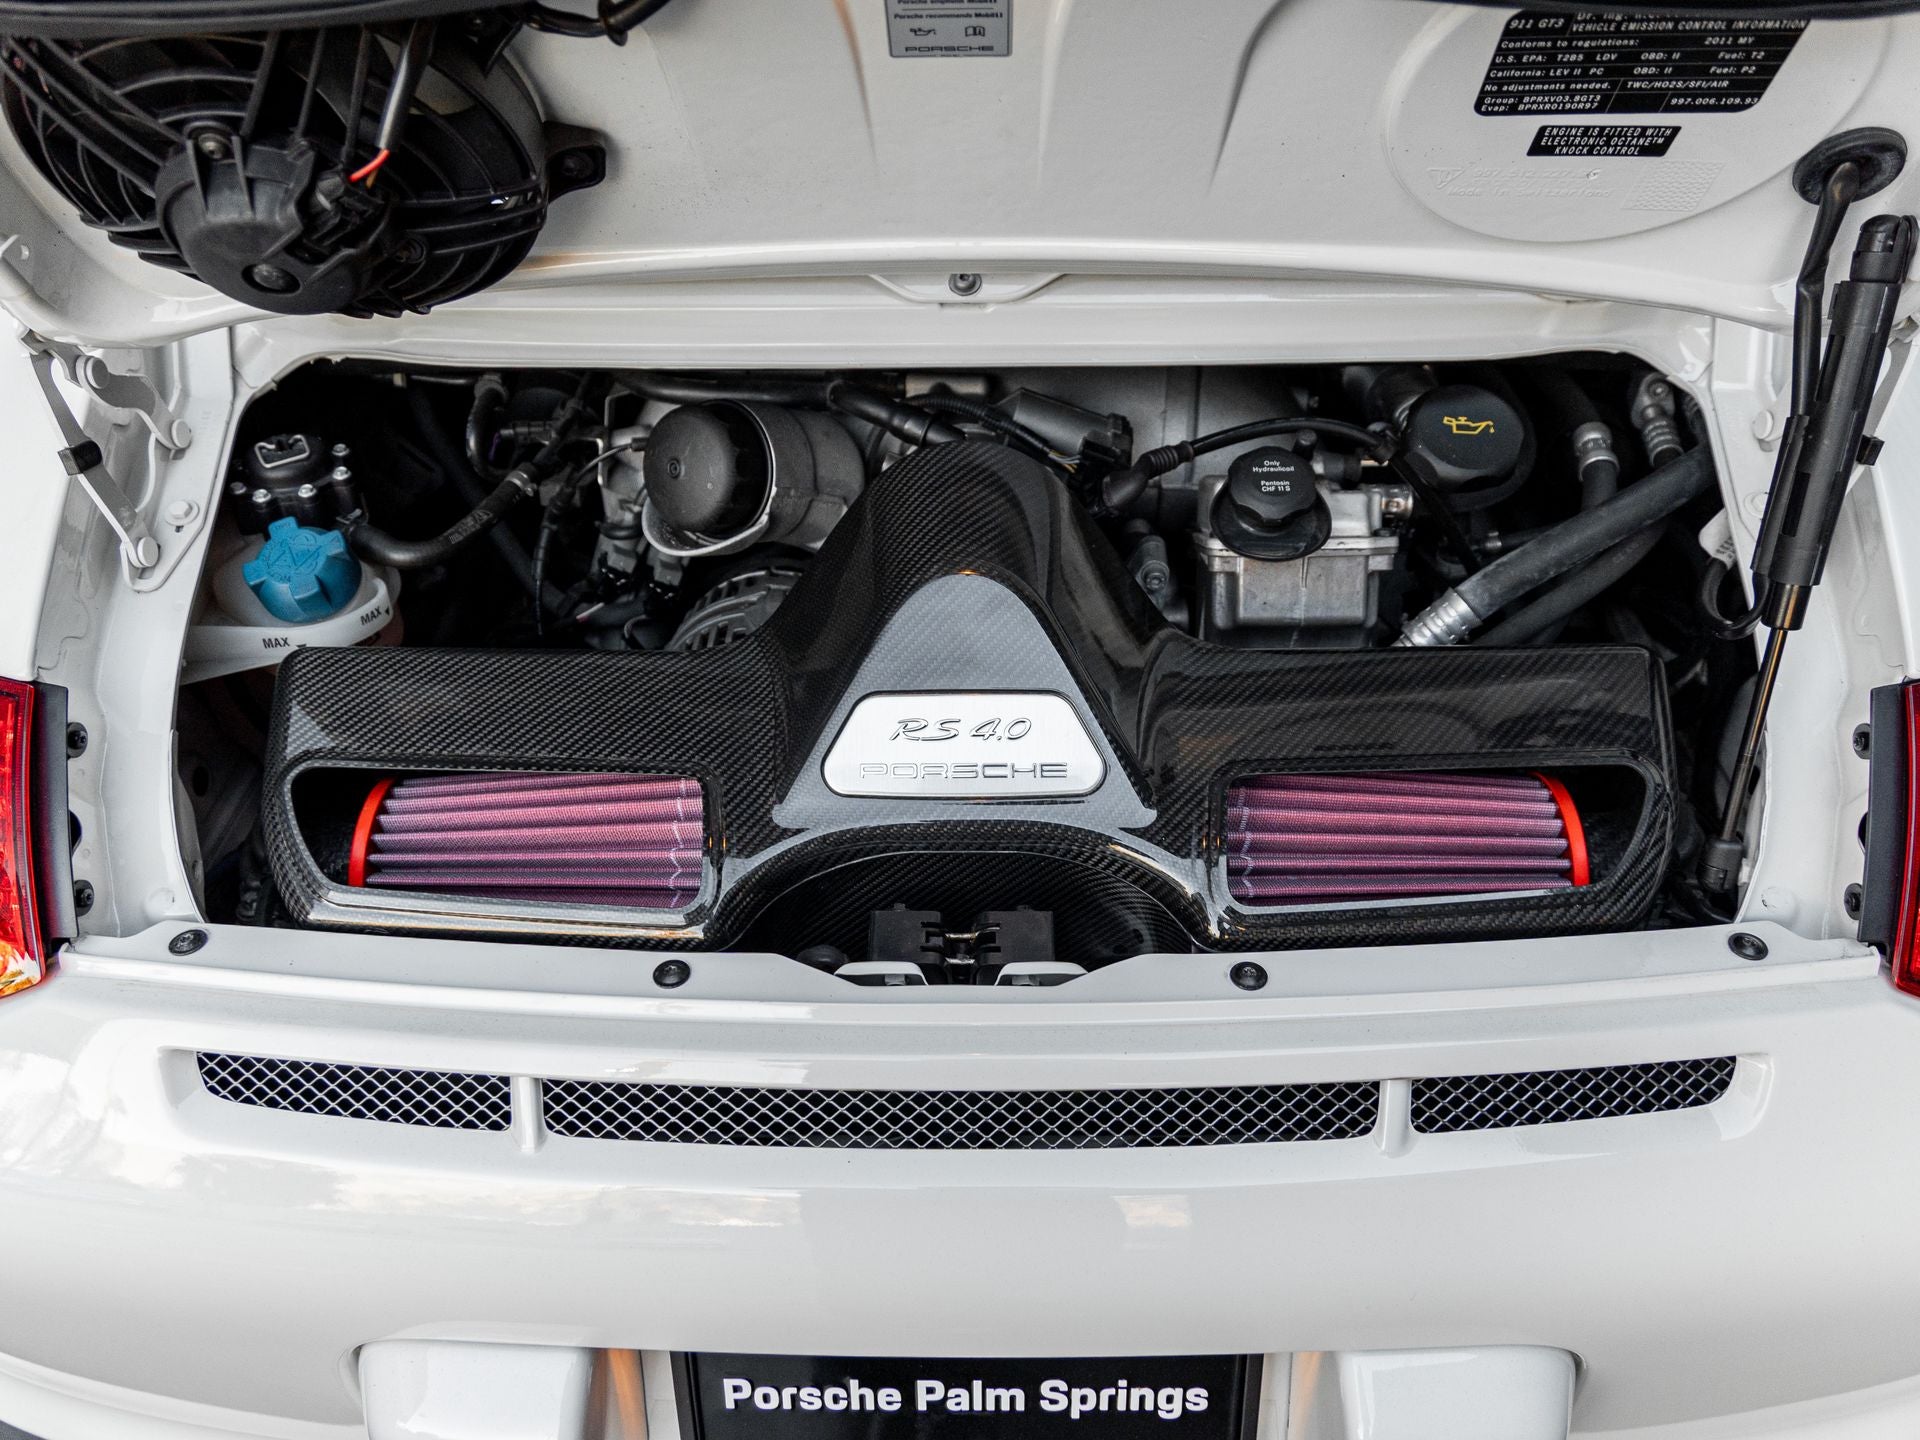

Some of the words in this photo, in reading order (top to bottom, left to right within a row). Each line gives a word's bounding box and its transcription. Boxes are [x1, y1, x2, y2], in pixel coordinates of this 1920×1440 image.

[1508, 19, 1534, 29] 911
[1538, 18, 1565, 29] GT3
[1572, 22, 1617, 32] VEHICLE
[1621, 21, 1674, 31] EMISSION
[1678, 20, 1728, 31] CONTROL
[1732, 19, 1807, 30] INFORMATION
[1501, 40, 1552, 49] Conforms
[1572, 38, 1640, 48] regulations:
[1704, 37, 1733, 45] 2011
[1737, 37, 1755, 45] MY
[1495, 55, 1517, 63] U.S.
[1522, 54, 1547, 63] EPA:
[1595, 53, 1618, 61] LDV
[1641, 52, 1668, 60] OBD:
[1718, 51, 1746, 60] Fuel:
[1751, 51, 1765, 60] T2
[1489, 69, 1546, 78] California:
[1549, 68, 1570, 76] LEV
[1589, 67, 1604, 75] PC
[1633, 67, 1660, 75] OBD:
[1709, 66, 1737, 74] Fuel:
[1740, 66, 1756, 74] P2
[1484, 84, 1498, 92] No
[1502, 83, 1565, 93] adjustments
[1569, 82, 1611, 90] needed.
[1484, 97, 1518, 105] Group:
[1481, 104, 1509, 112] Evap:
[1544, 127, 1584, 136] ENGINE
[1588, 127, 1600, 136] IS
[1603, 127, 1641, 136] FITTED
[1645, 128, 1673, 136] WITH
[1540, 137, 1607, 146] ELECTRONIC
[1554, 146, 1590, 154] KNOCK
[1593, 146, 1640, 155] CONTROL
[360, 606, 382, 625] MAX
[262, 637, 291, 649] MAX
[888, 717, 961, 741] RS
[970, 717, 1032, 741] 4.0
[859, 762, 1068, 779] PORSCHE
[723, 1378, 902, 1411] Porsche
[916, 1380, 1026, 1411] Palm
[1039, 1379, 1209, 1419] Springs
